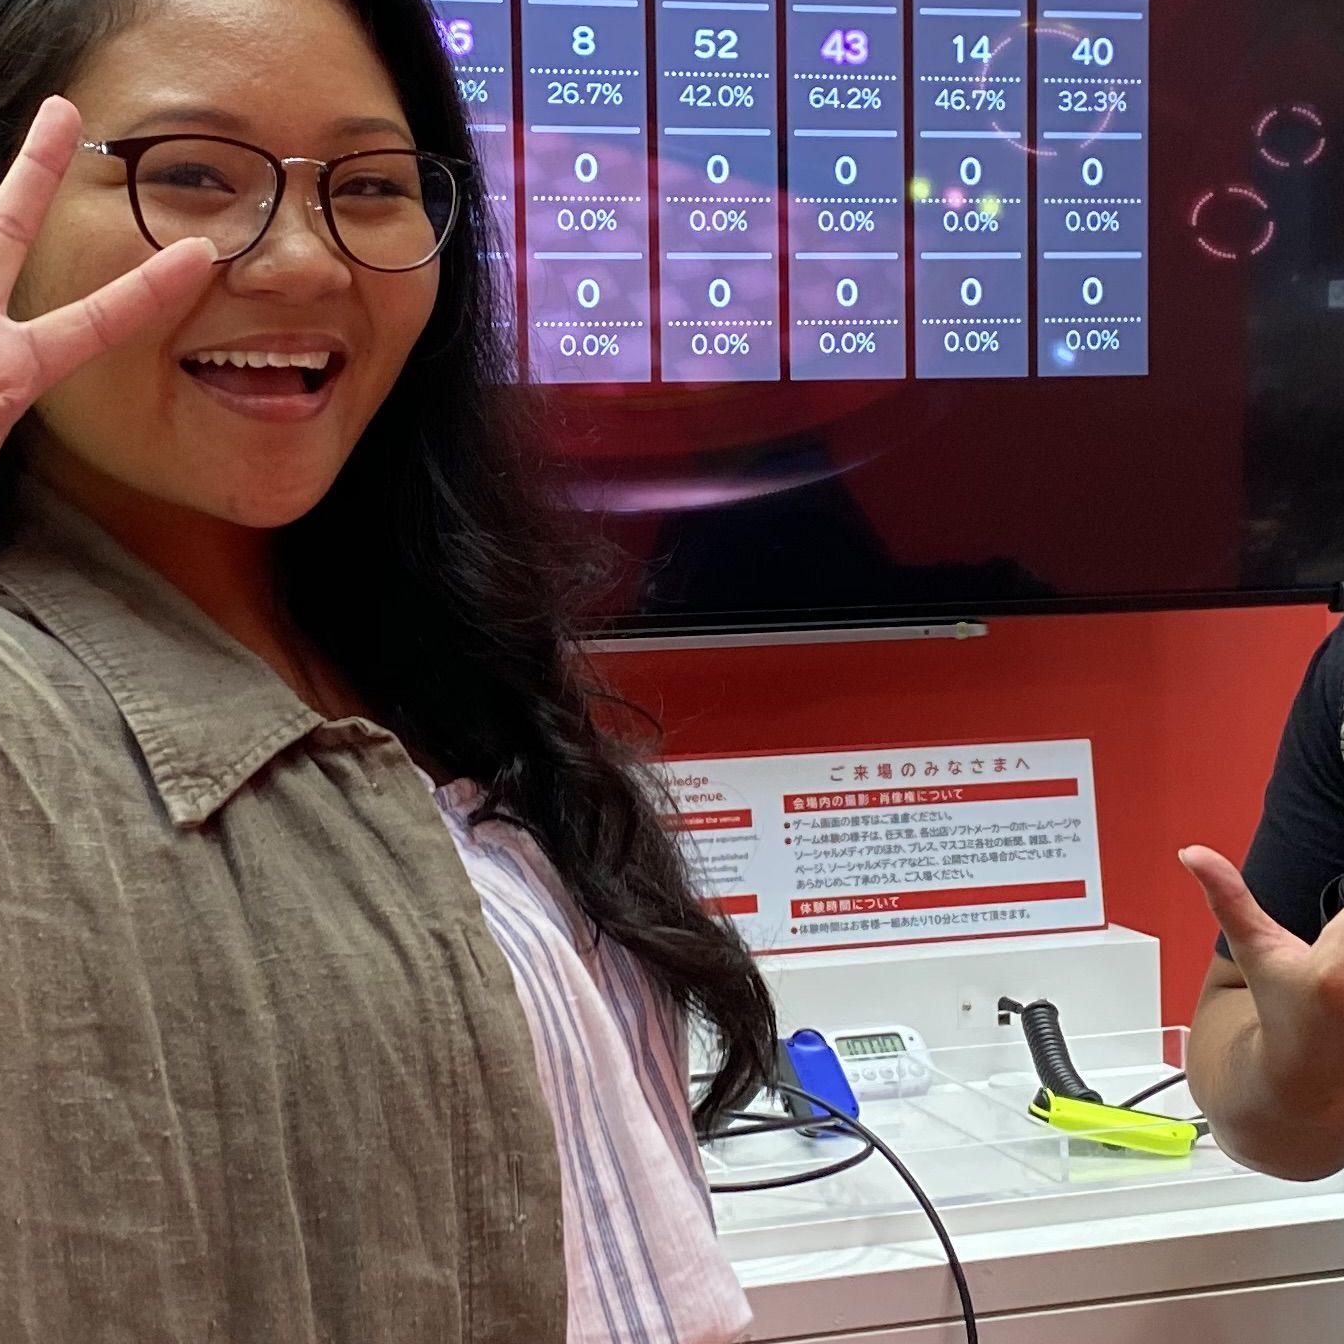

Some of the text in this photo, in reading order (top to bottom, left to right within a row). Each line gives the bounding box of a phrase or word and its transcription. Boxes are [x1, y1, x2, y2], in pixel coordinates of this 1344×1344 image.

[441, 20, 1114, 66] 6 8 52 43 14 40
[547, 81, 1127, 112] 26.7% 42.0% 64.2% 46.7% 32.3%
[574, 152, 1103, 186] 0 0 0 0 0
[557, 208, 1120, 232] 0.0% 0.0% 0.0% 0.0% 0.0%
[577, 276, 1103, 308] 0 0 0 0 0
[559, 329, 1120, 357] 0.0% 0.0% 0.0% 0.0% 0.0%
[829, 757, 1032, 782] ご来場のみなさまへ
[799, 895, 901, 915] 体験時間について
